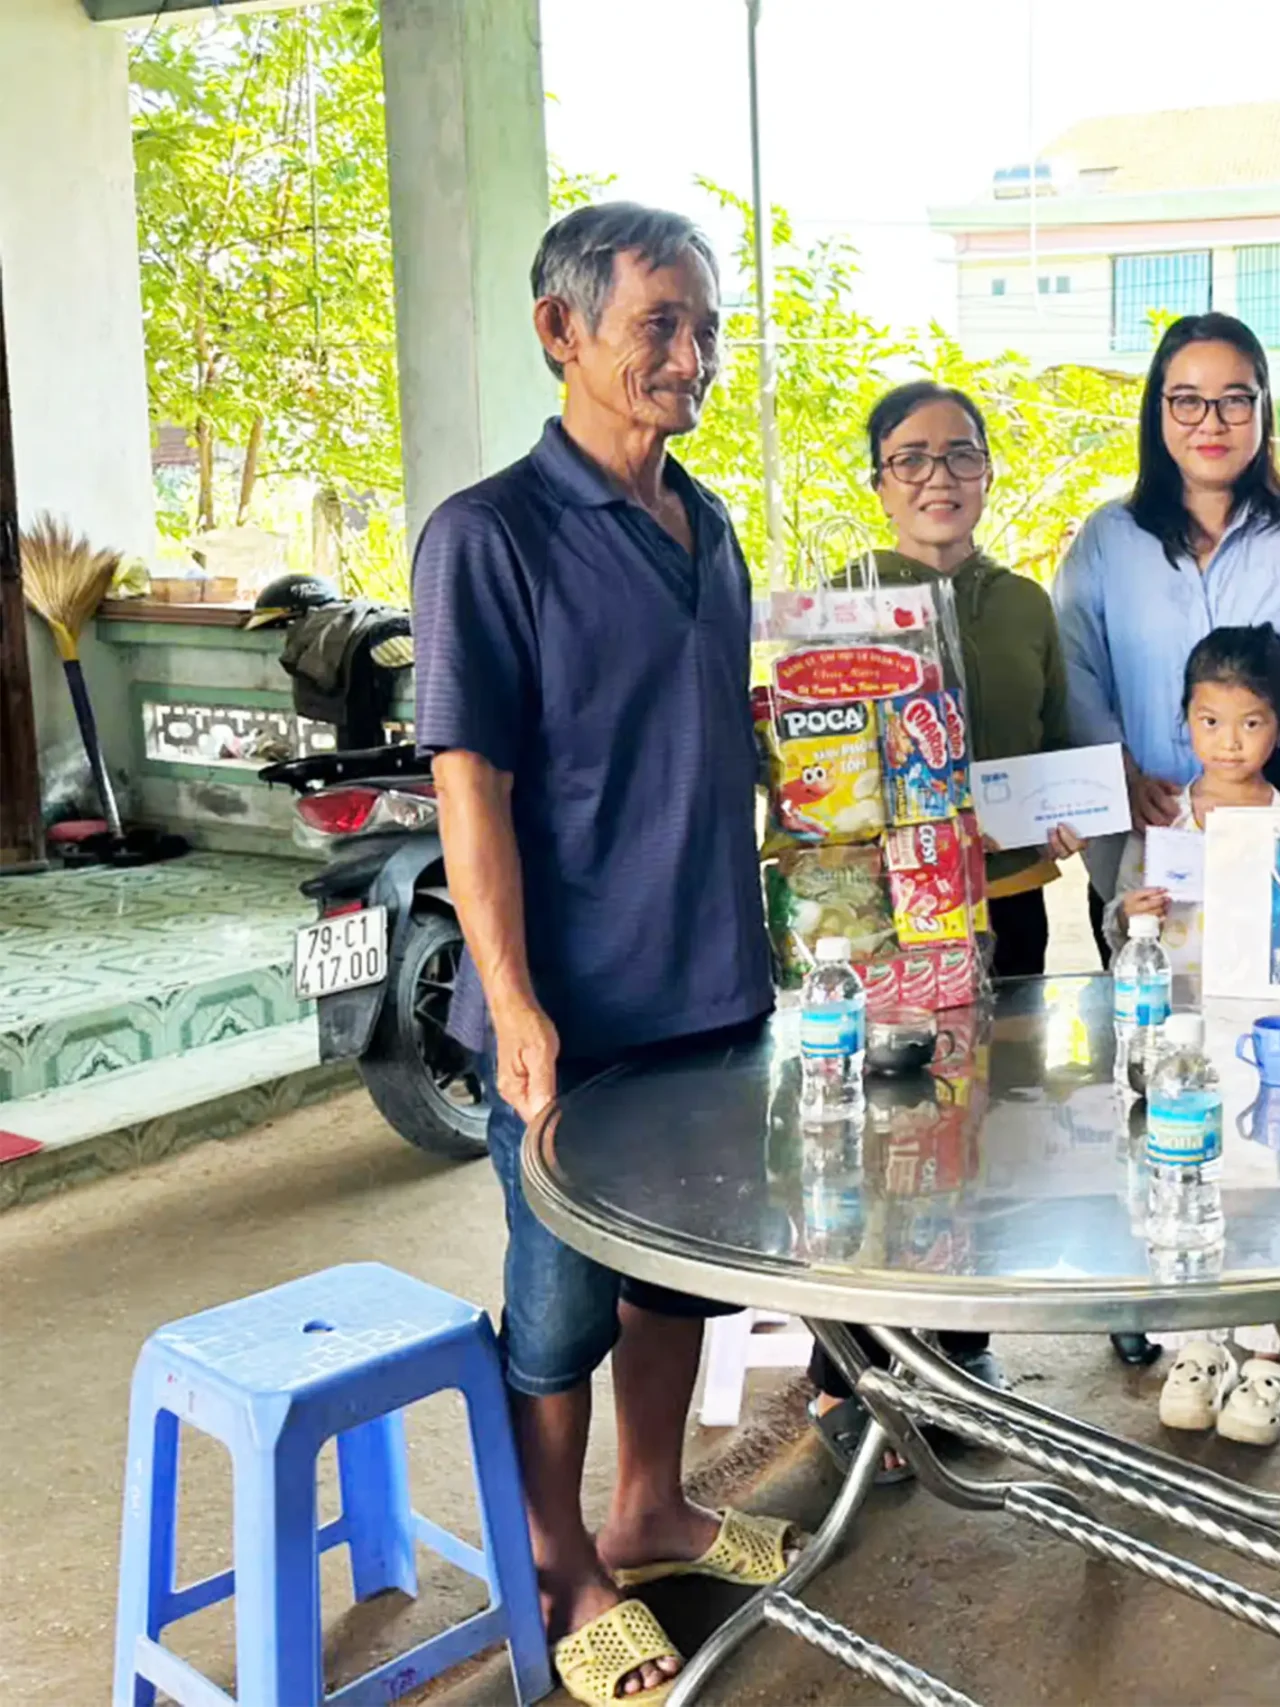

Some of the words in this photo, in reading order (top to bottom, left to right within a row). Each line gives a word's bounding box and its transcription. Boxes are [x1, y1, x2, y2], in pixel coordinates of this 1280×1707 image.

[783, 708, 864, 737] POCA
[307, 916, 367, 960] 79-C1
[299, 946, 379, 993] 417.00
